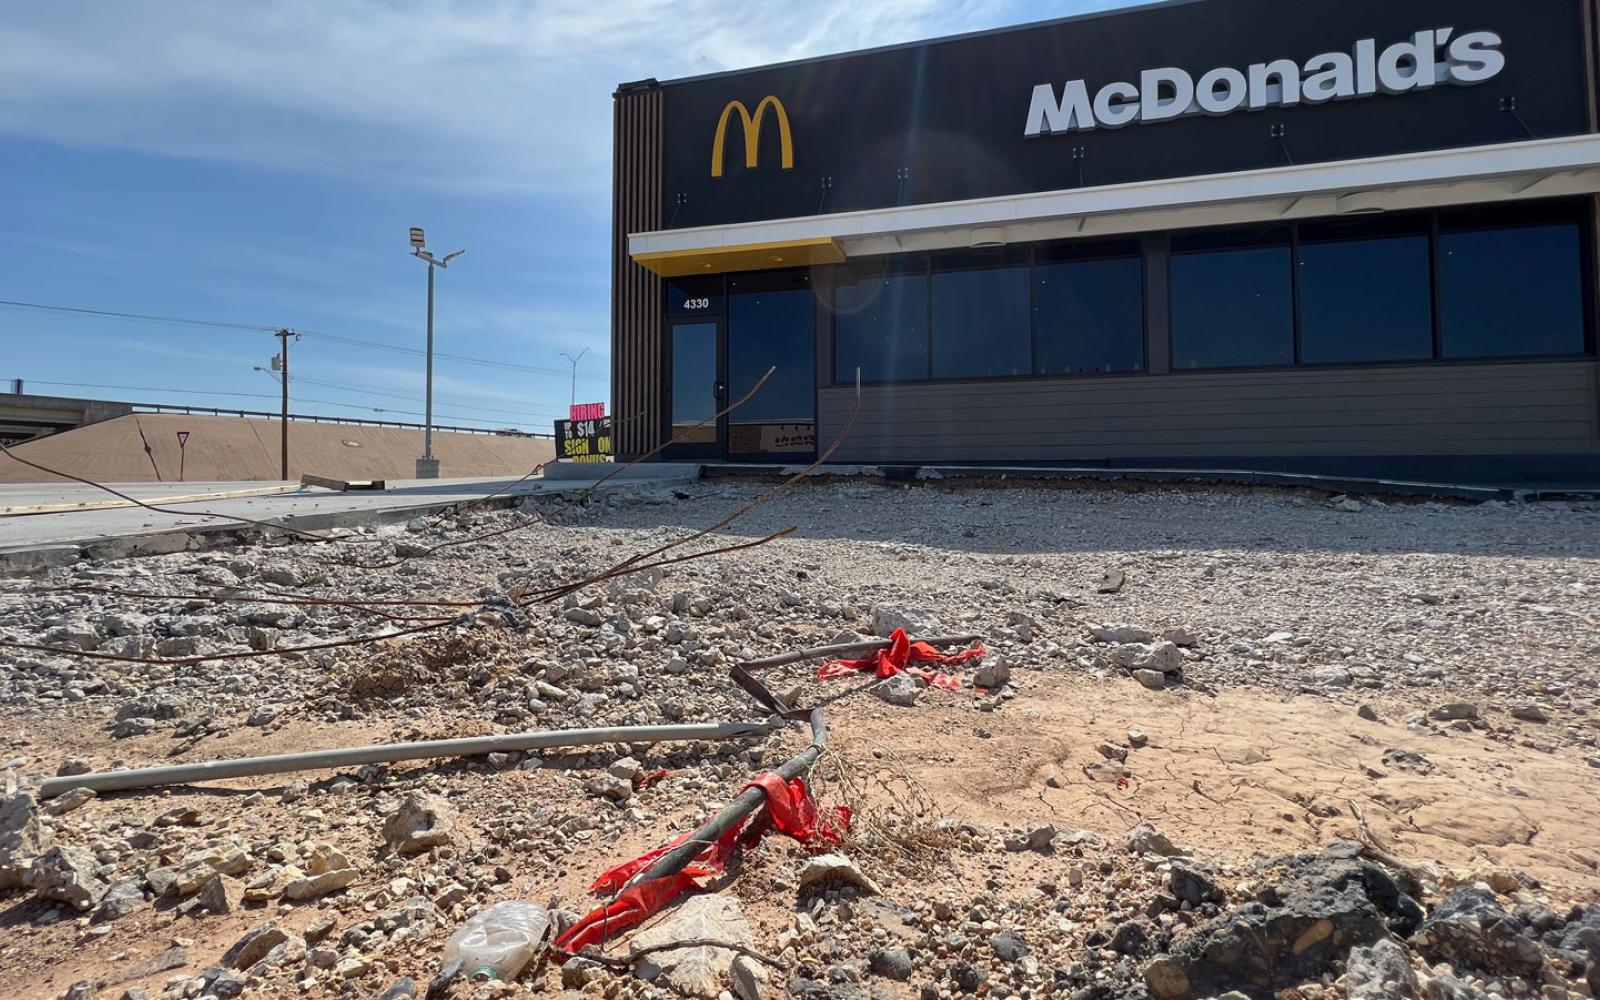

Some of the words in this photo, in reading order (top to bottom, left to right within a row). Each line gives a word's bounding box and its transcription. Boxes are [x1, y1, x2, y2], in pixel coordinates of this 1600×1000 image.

[1024, 26, 1505, 136] McDonald's
[683, 297, 709, 309] 4330
[570, 403, 605, 421] HIRING
[564, 438, 589, 455] SIGN
[598, 436, 611, 453] ON
